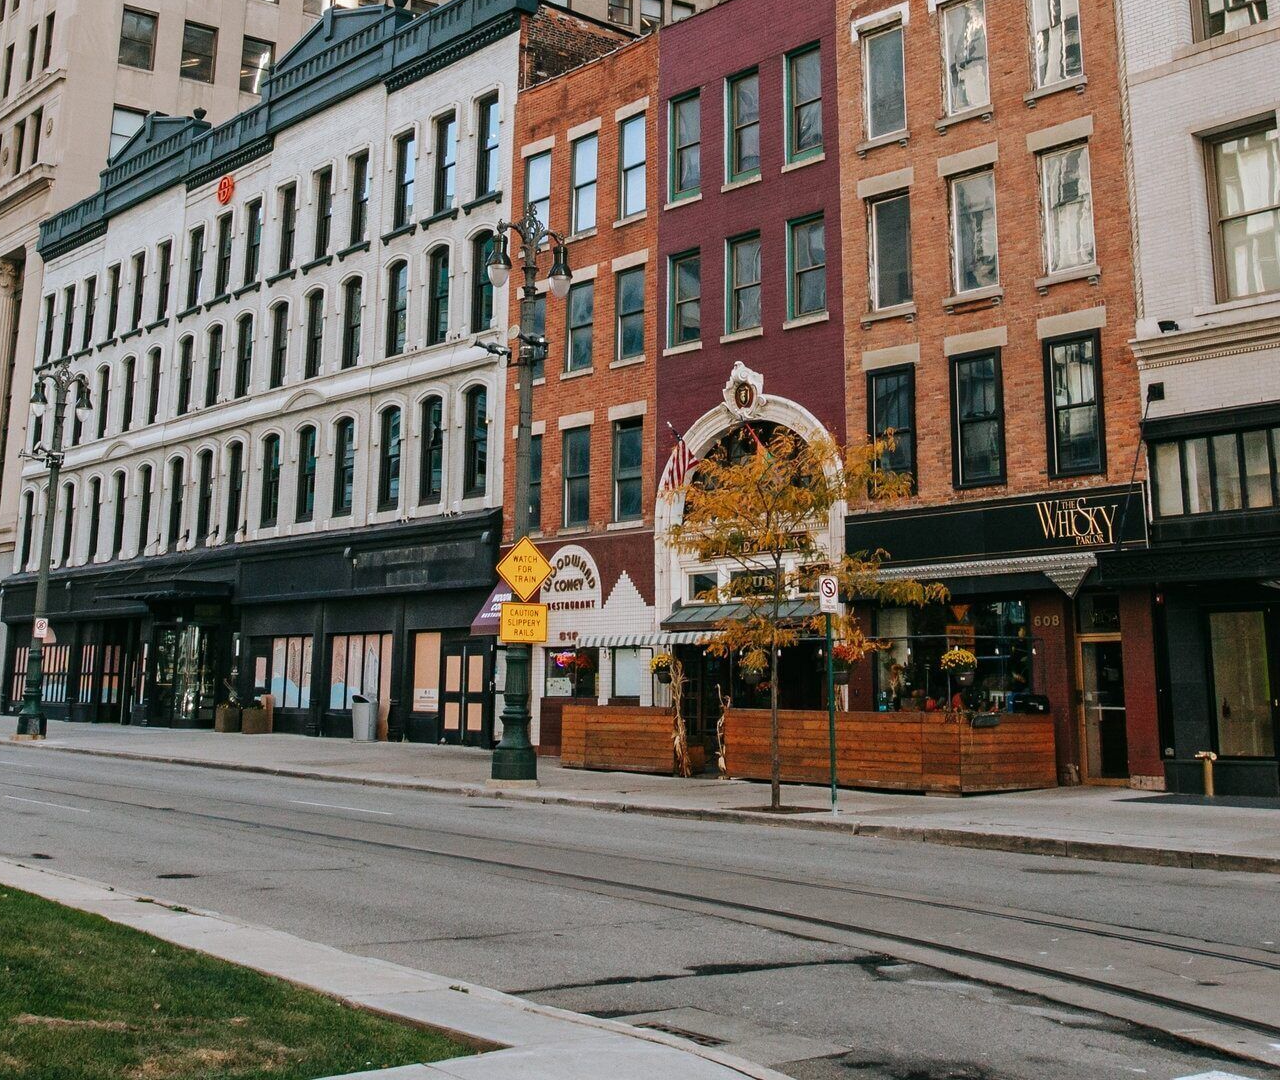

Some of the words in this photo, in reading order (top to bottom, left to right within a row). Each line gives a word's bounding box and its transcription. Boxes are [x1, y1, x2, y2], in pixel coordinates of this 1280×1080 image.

[1061, 500, 1076, 510] THE
[1035, 497, 1119, 545] WHISKY
[1075, 533, 1105, 546] PARLOR
[513, 555, 538, 563] WATCH
[517, 565, 533, 573] FOR
[543, 554, 596, 593] WOODWARD
[514, 575, 537, 583] TRAIN
[554, 578, 584, 593] CONEY
[547, 599, 596, 611] RESTAURANT
[509, 609, 539, 617] CAUTION
[507, 618, 541, 627] SLIPPERY
[1034, 614, 1060, 627] 608
[513, 628, 535, 637] RAILS
